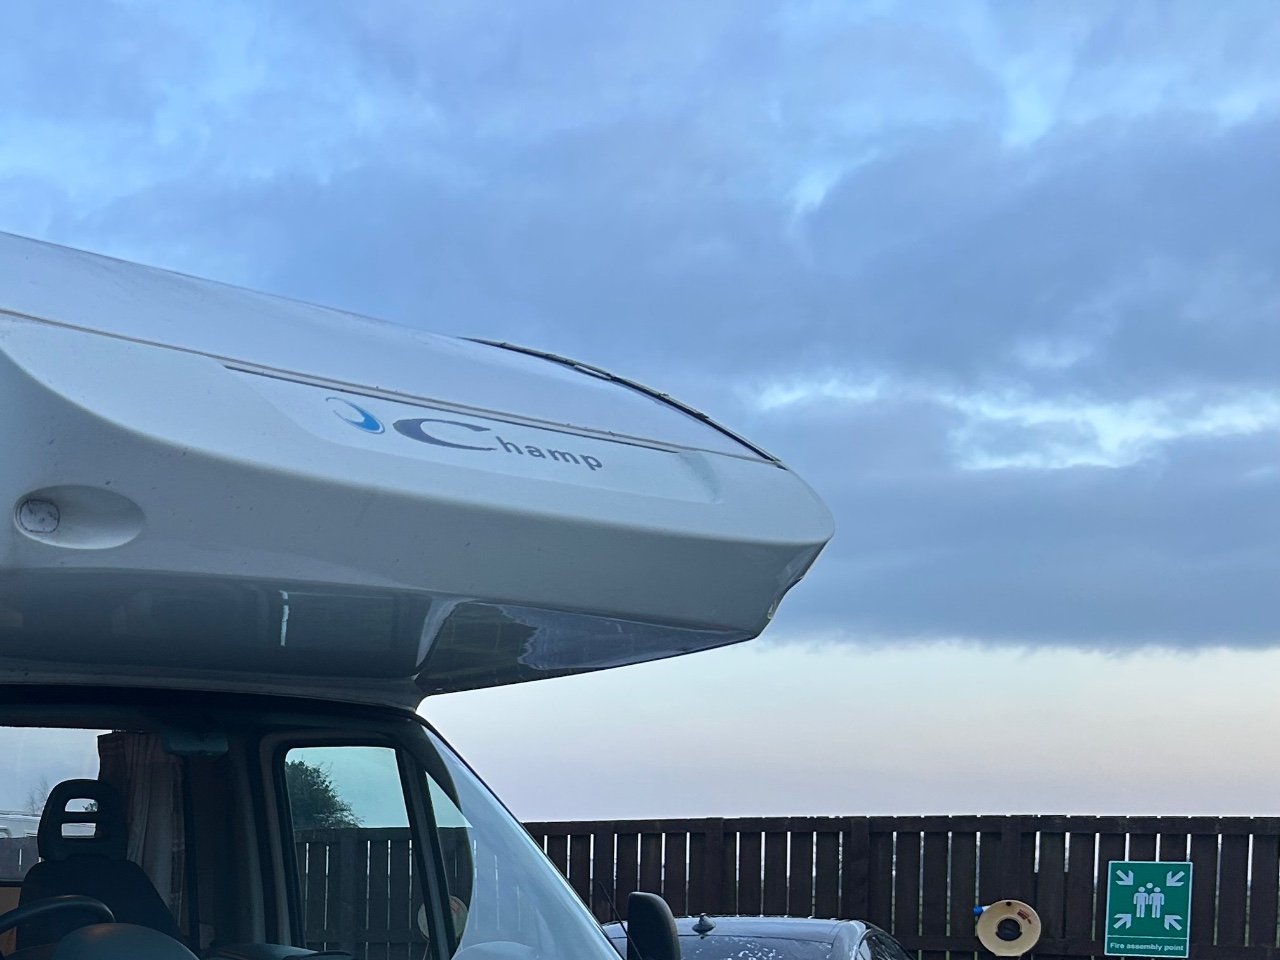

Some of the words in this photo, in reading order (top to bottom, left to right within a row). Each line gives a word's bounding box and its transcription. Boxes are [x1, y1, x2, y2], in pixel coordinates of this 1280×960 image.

[392, 418, 602, 471] Champ
[1126, 943, 1163, 951] assembly
[1164, 944, 1184, 952] point
